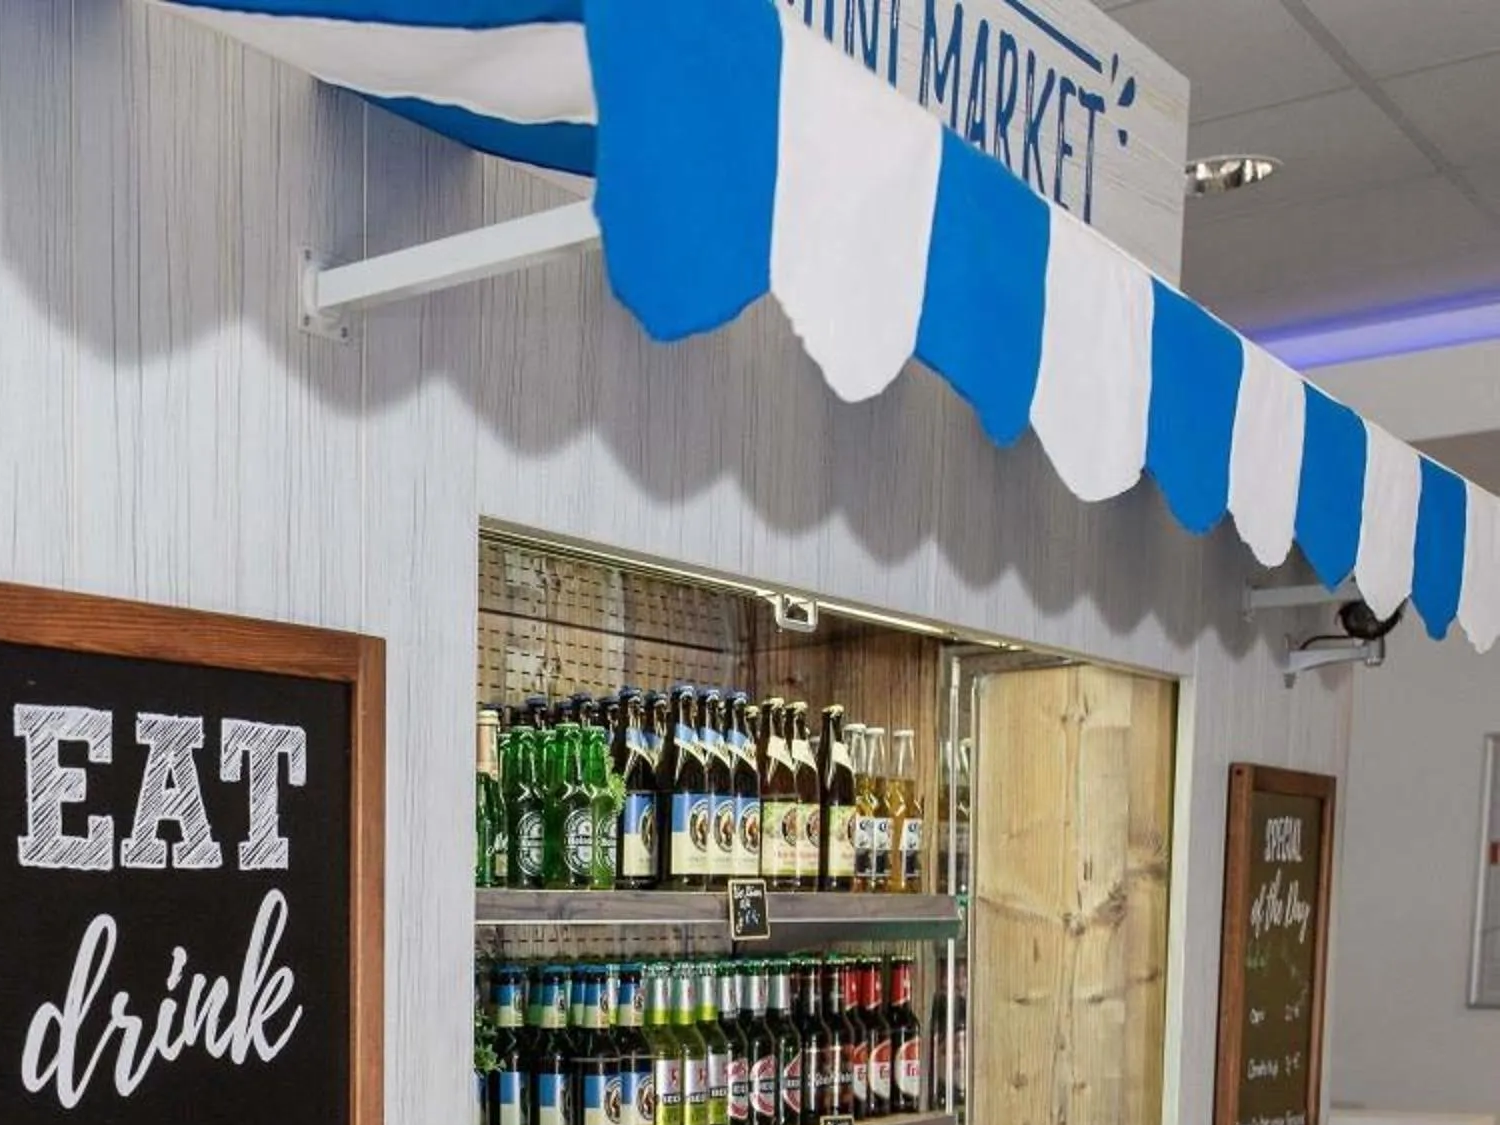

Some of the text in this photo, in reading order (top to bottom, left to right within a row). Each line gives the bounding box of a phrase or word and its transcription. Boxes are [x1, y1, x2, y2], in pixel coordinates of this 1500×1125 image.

[787, 0, 1106, 224] NI MARKET
[13, 702, 307, 871] EAT
[20, 888, 304, 1109] drink
